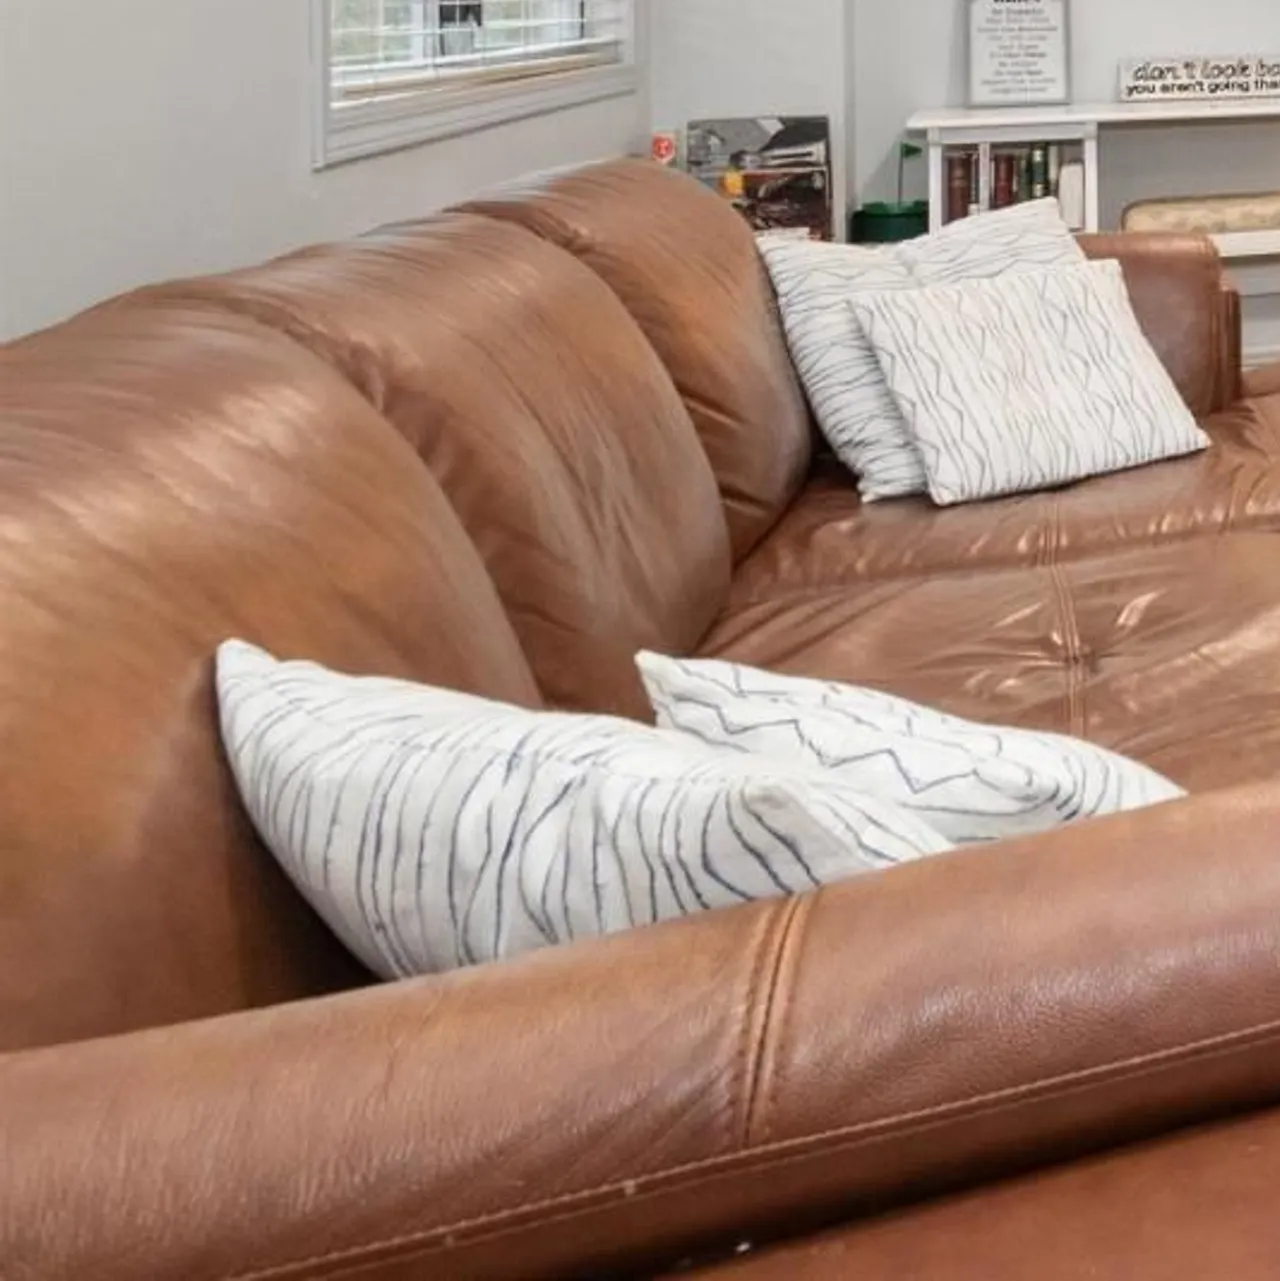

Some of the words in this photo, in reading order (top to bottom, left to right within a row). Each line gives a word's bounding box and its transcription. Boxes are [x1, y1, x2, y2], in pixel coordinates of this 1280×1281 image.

[1133, 60, 1197, 81] don't
[1199, 58, 1251, 79] look
[1126, 83, 1156, 97] you
[1159, 80, 1205, 93] aren't
[1207, 80, 1250, 94] going
